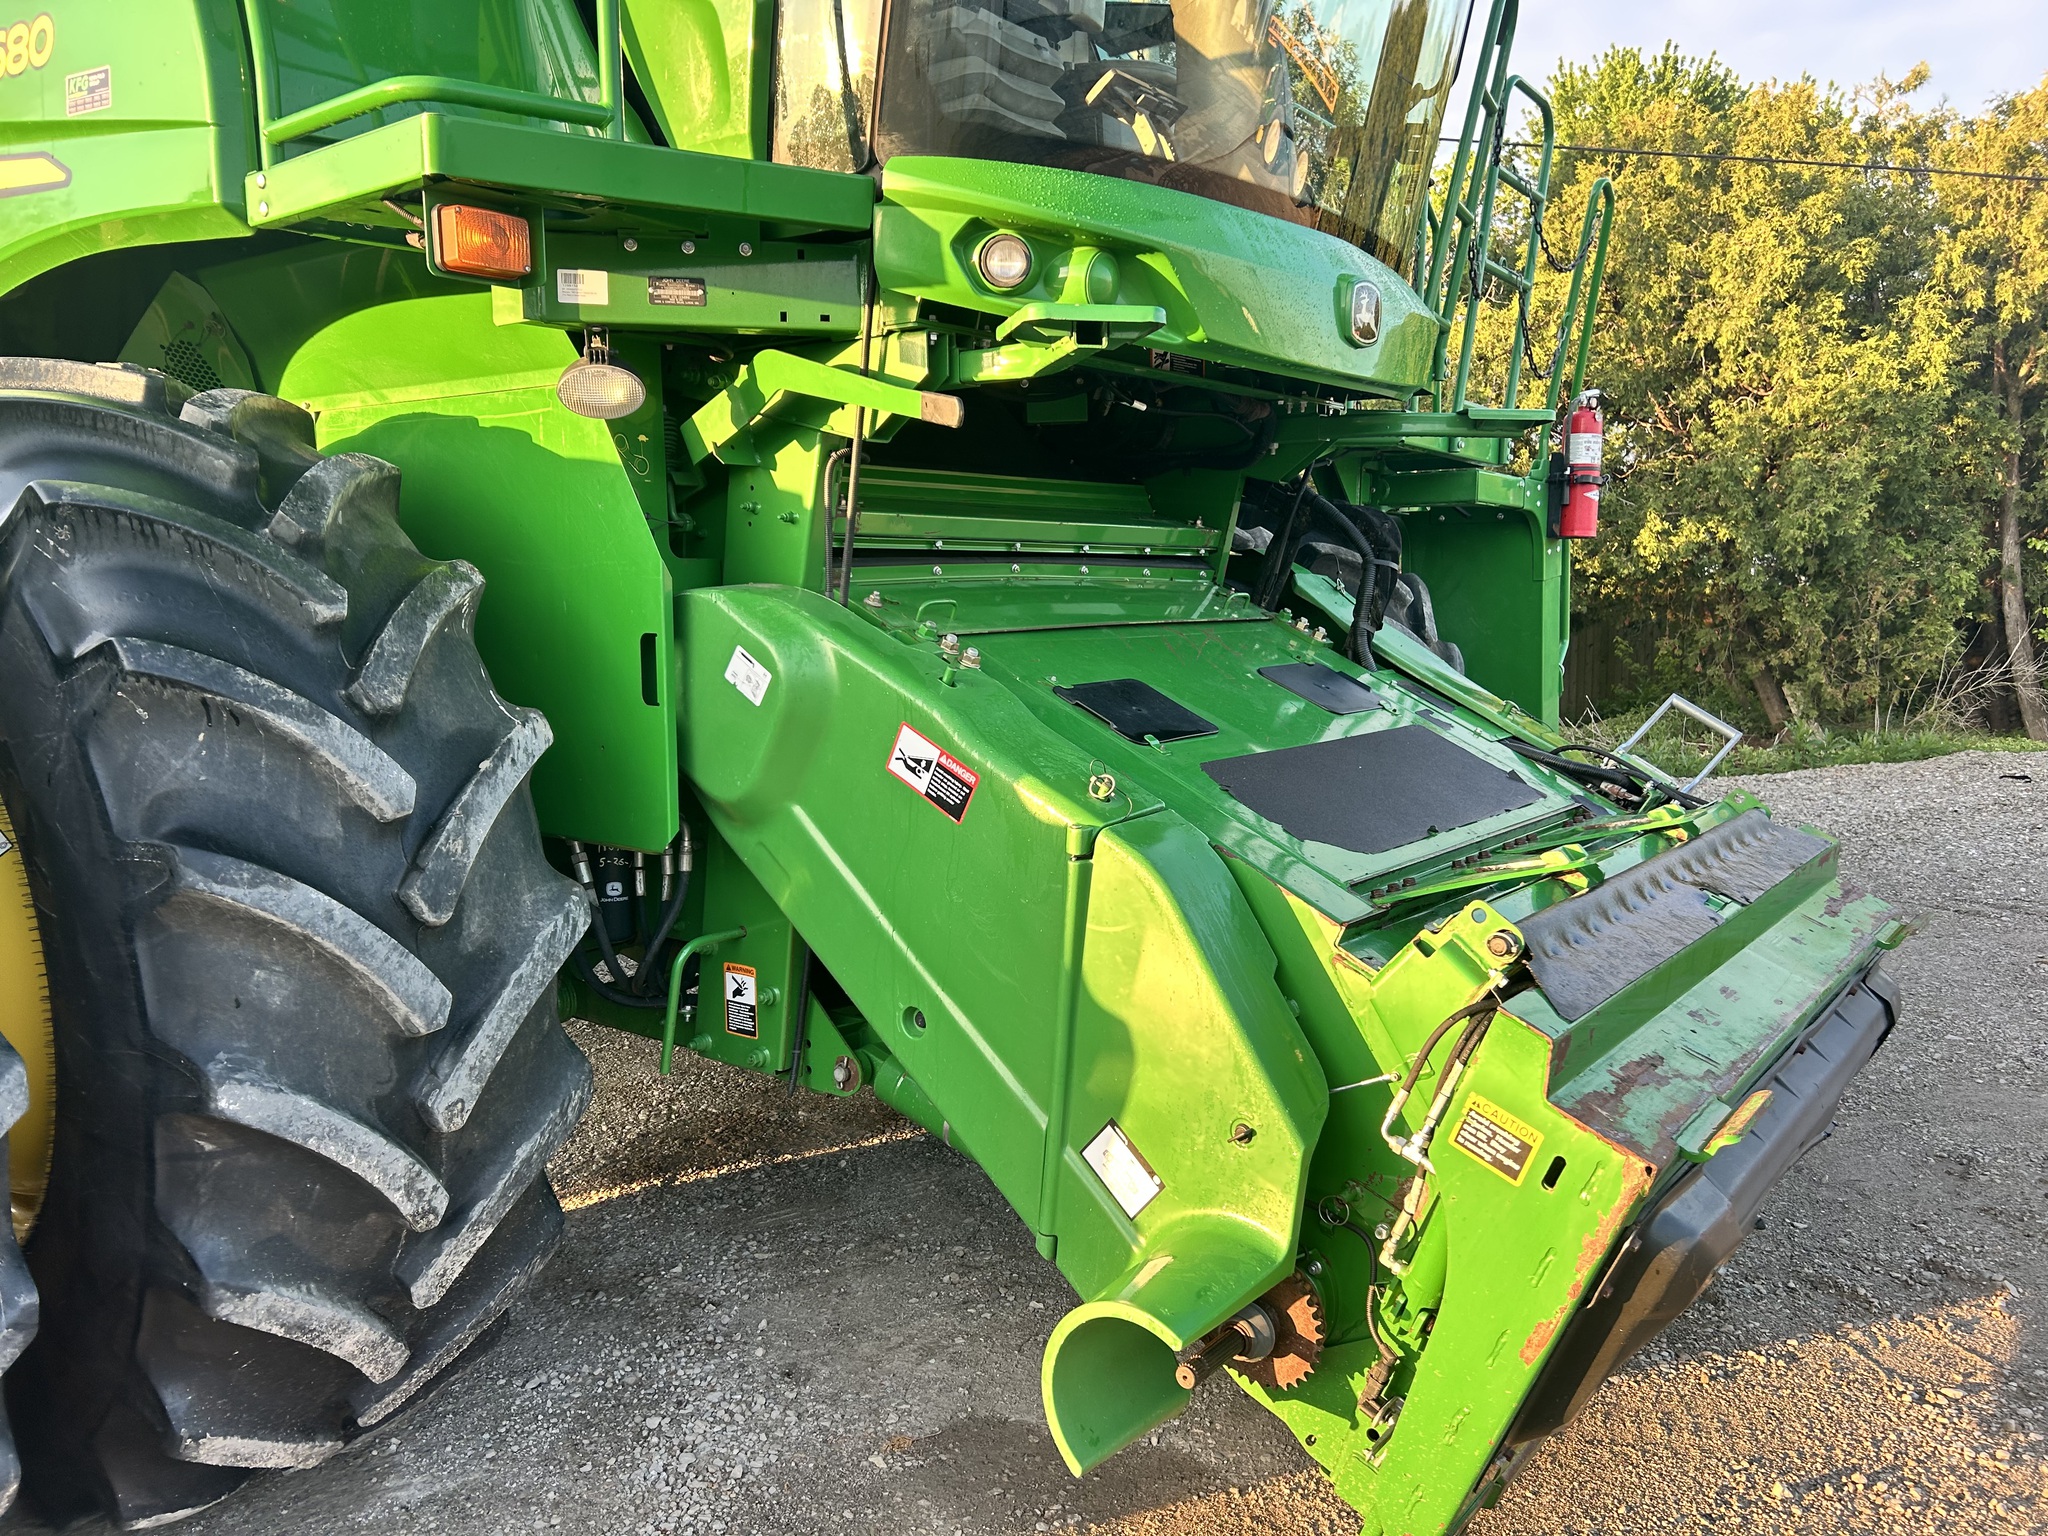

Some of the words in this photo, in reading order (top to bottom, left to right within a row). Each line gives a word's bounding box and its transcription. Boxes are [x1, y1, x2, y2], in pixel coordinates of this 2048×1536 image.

[69, 75, 89, 95] KFG
[946, 757, 977, 785] DANGER
[731, 965, 755, 976] WARNING
[1482, 1103, 1539, 1144] CAUTION
